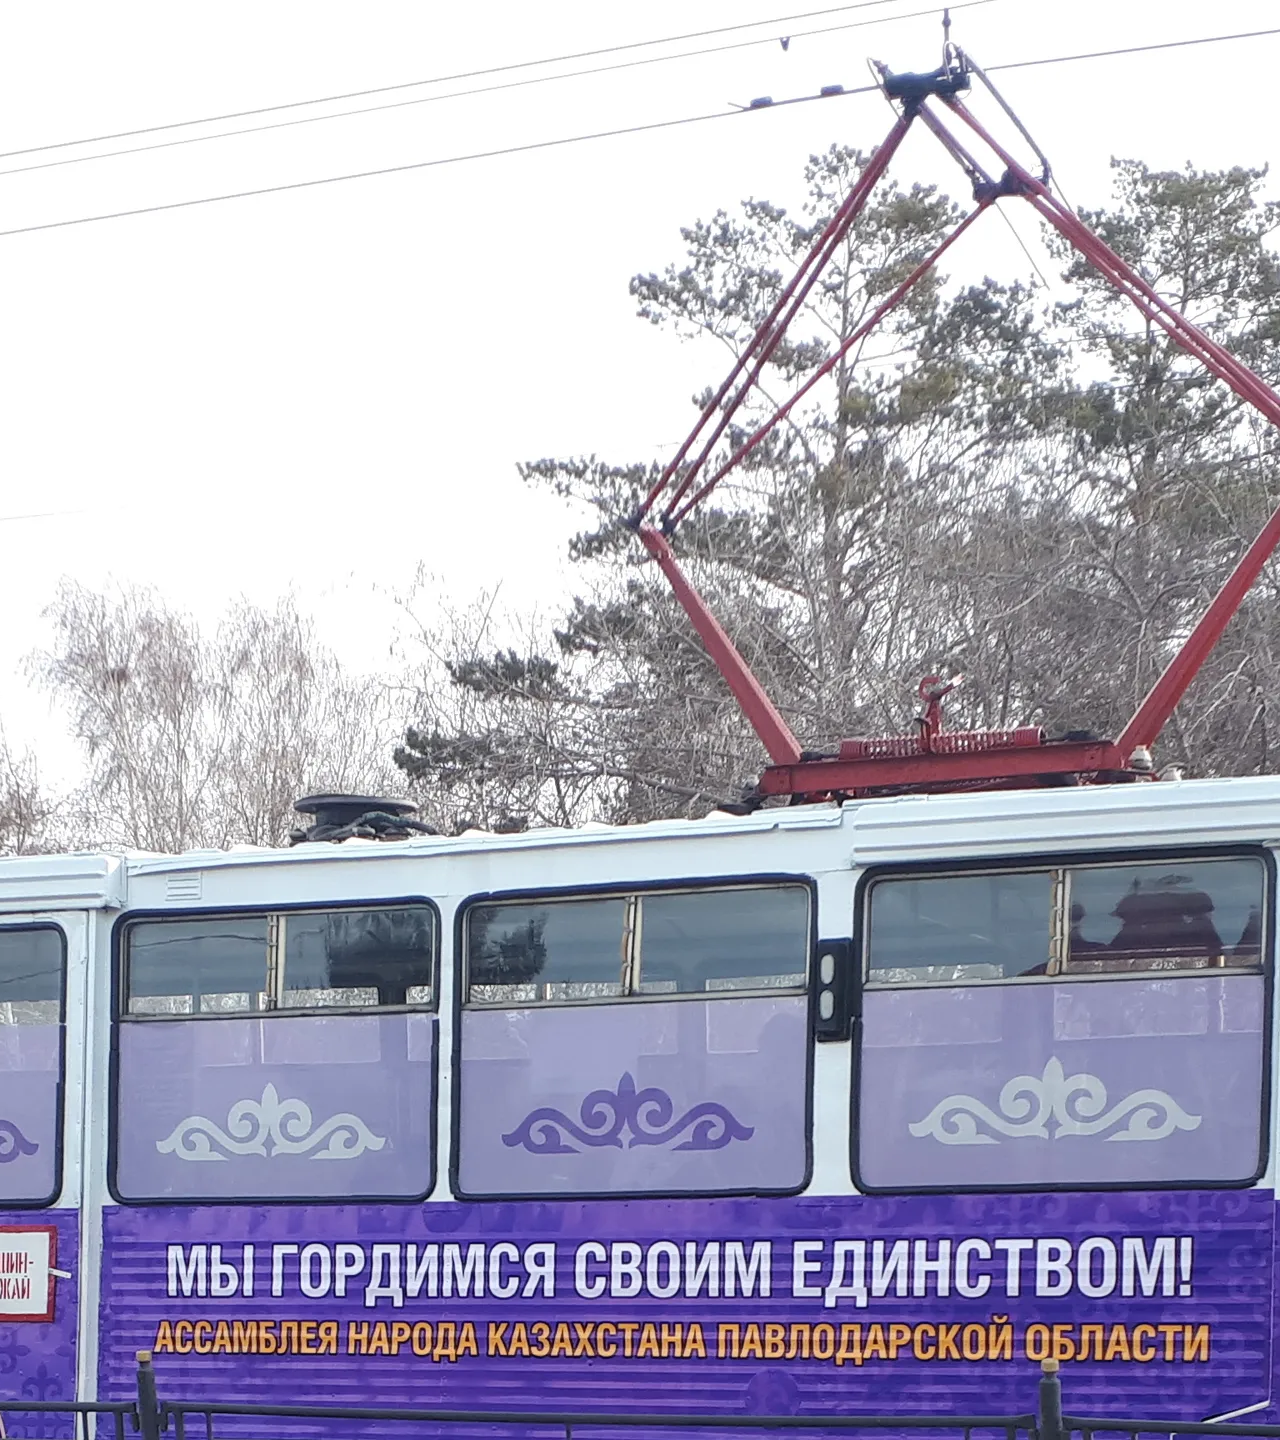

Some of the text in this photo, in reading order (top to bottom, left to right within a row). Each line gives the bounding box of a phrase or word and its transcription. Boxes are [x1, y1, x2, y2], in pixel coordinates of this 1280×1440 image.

[166, 1235, 1195, 1309] МЫ ГОРДИМСЯ СВОИМ ЕДИНСТВОМ!
[153, 1315, 1210, 1366] АССАМБЛЕЯ НАРОДА КАЗАХСТАНА ПАВЛОДАРСКОЙ ОБЛАСТИ
